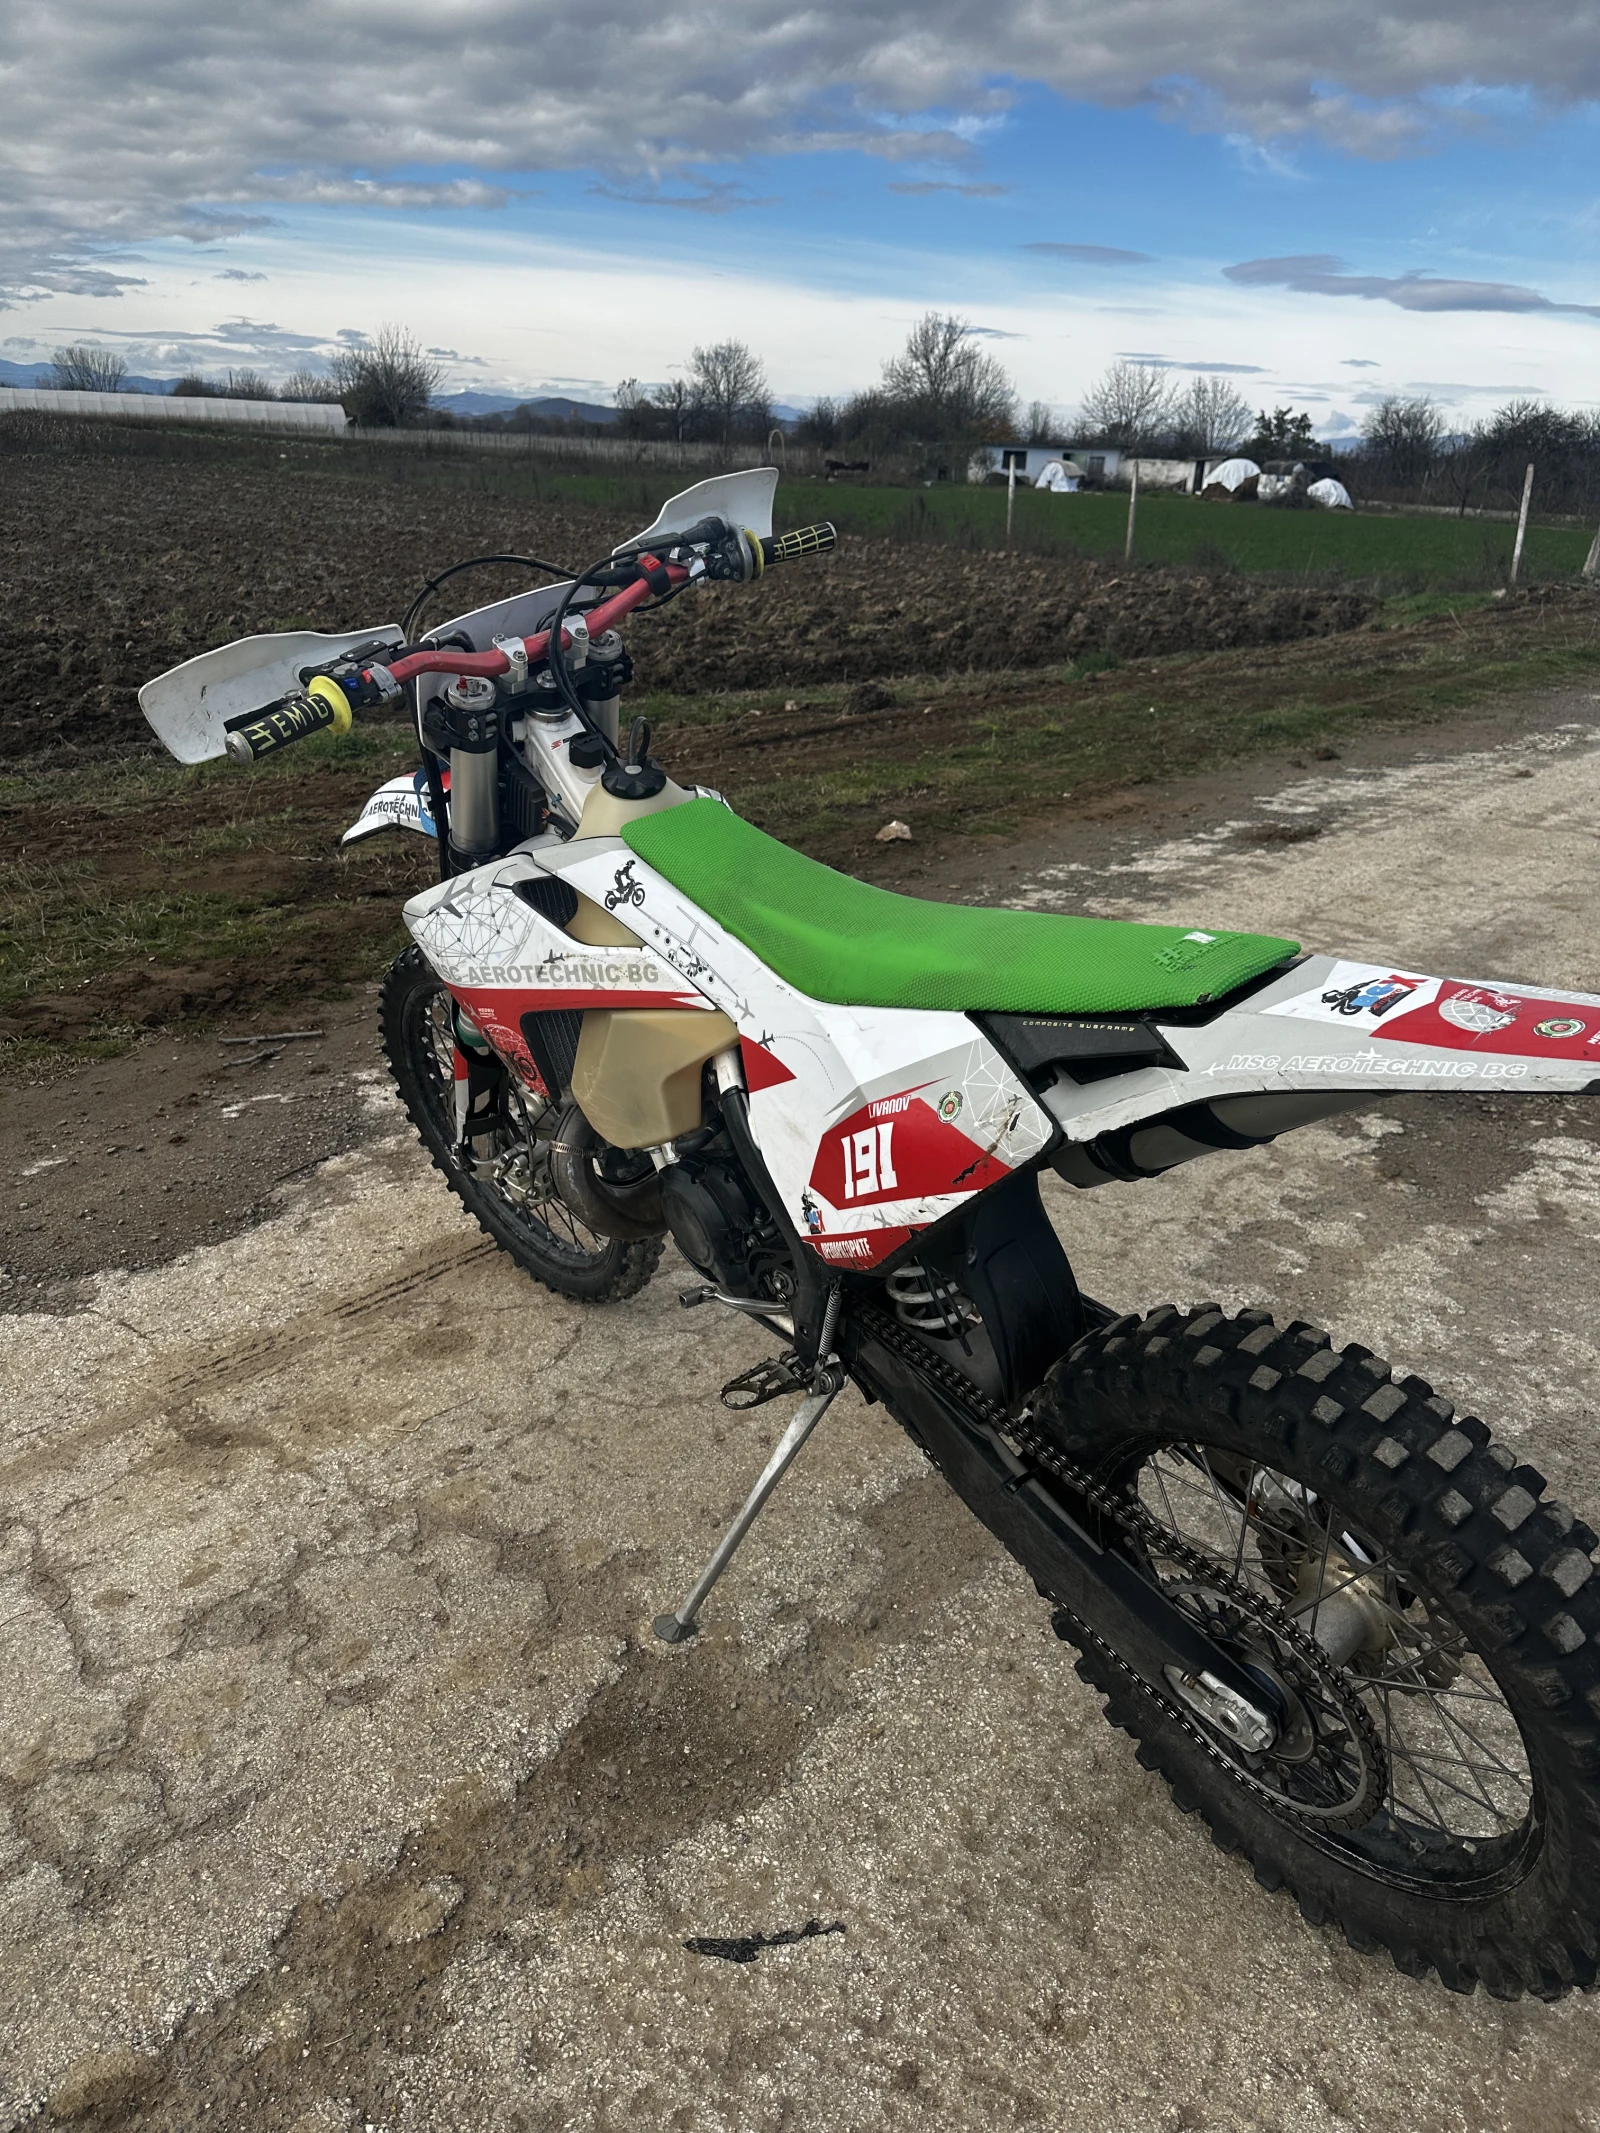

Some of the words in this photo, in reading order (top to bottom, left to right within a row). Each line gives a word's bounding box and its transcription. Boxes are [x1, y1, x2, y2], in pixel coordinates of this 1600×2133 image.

[468, 964, 620, 983] AEROTECHNIC
[627, 963, 659, 983] BG
[1022, 1020, 1074, 1029] COMPOSITE
[1227, 1055, 1281, 1070] MSC
[1281, 1056, 1477, 1077] AEROTECHNIC
[1481, 1062, 1528, 1078] BG
[840, 1121, 899, 1200] 191
